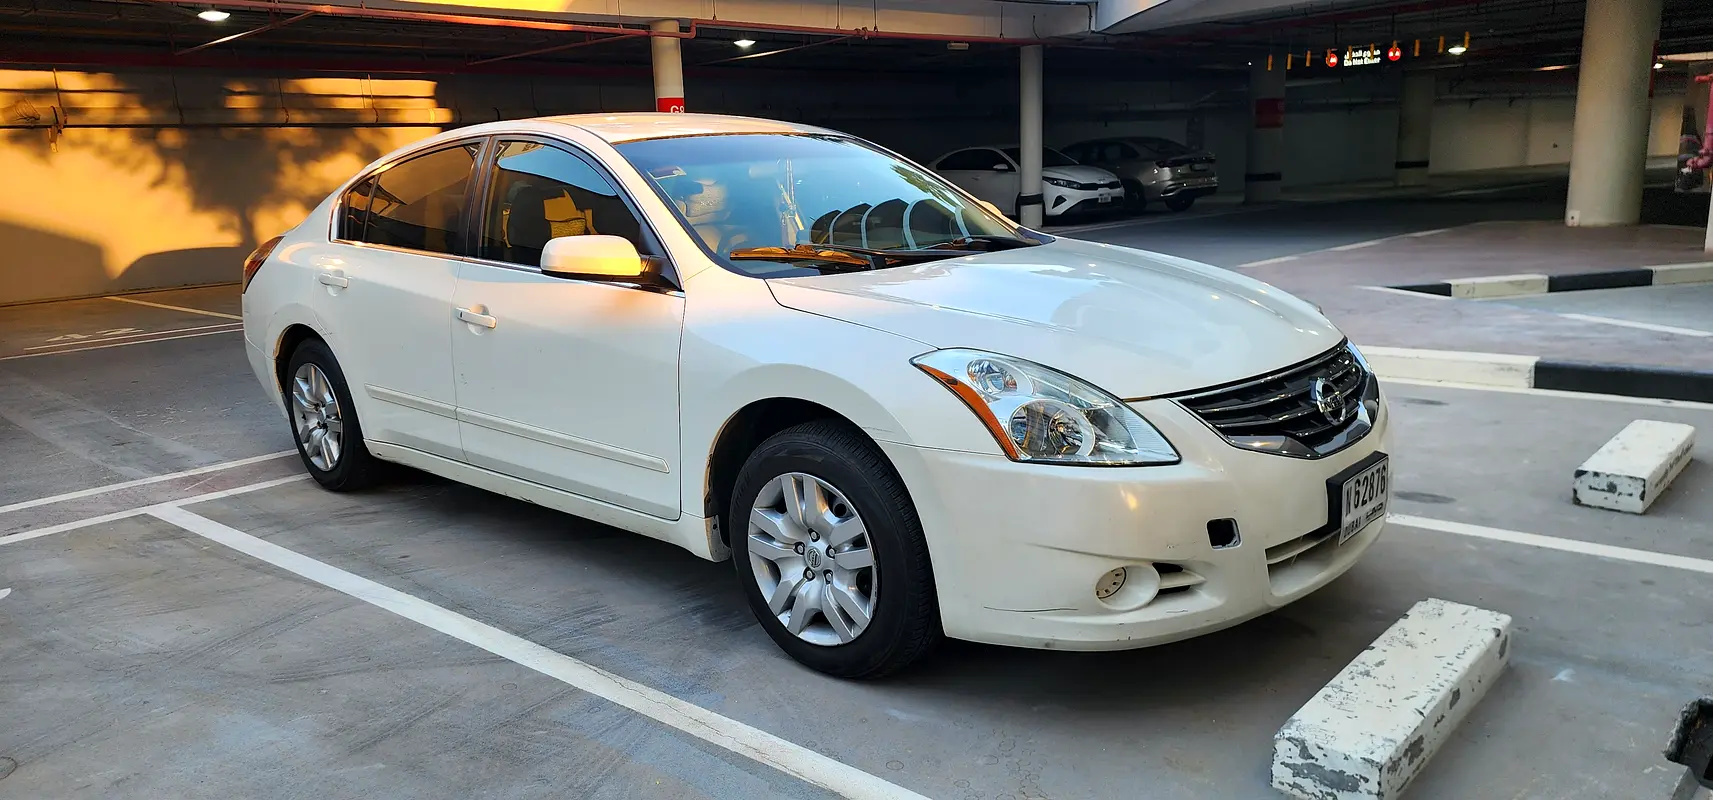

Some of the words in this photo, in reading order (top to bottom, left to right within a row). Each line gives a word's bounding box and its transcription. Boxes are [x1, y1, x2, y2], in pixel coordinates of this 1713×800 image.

[1344, 50, 1362, 59] الدخل
[1345, 486, 1352, 517] N
[1354, 464, 1386, 509] 62876
[1344, 516, 1361, 538] DUBAI
